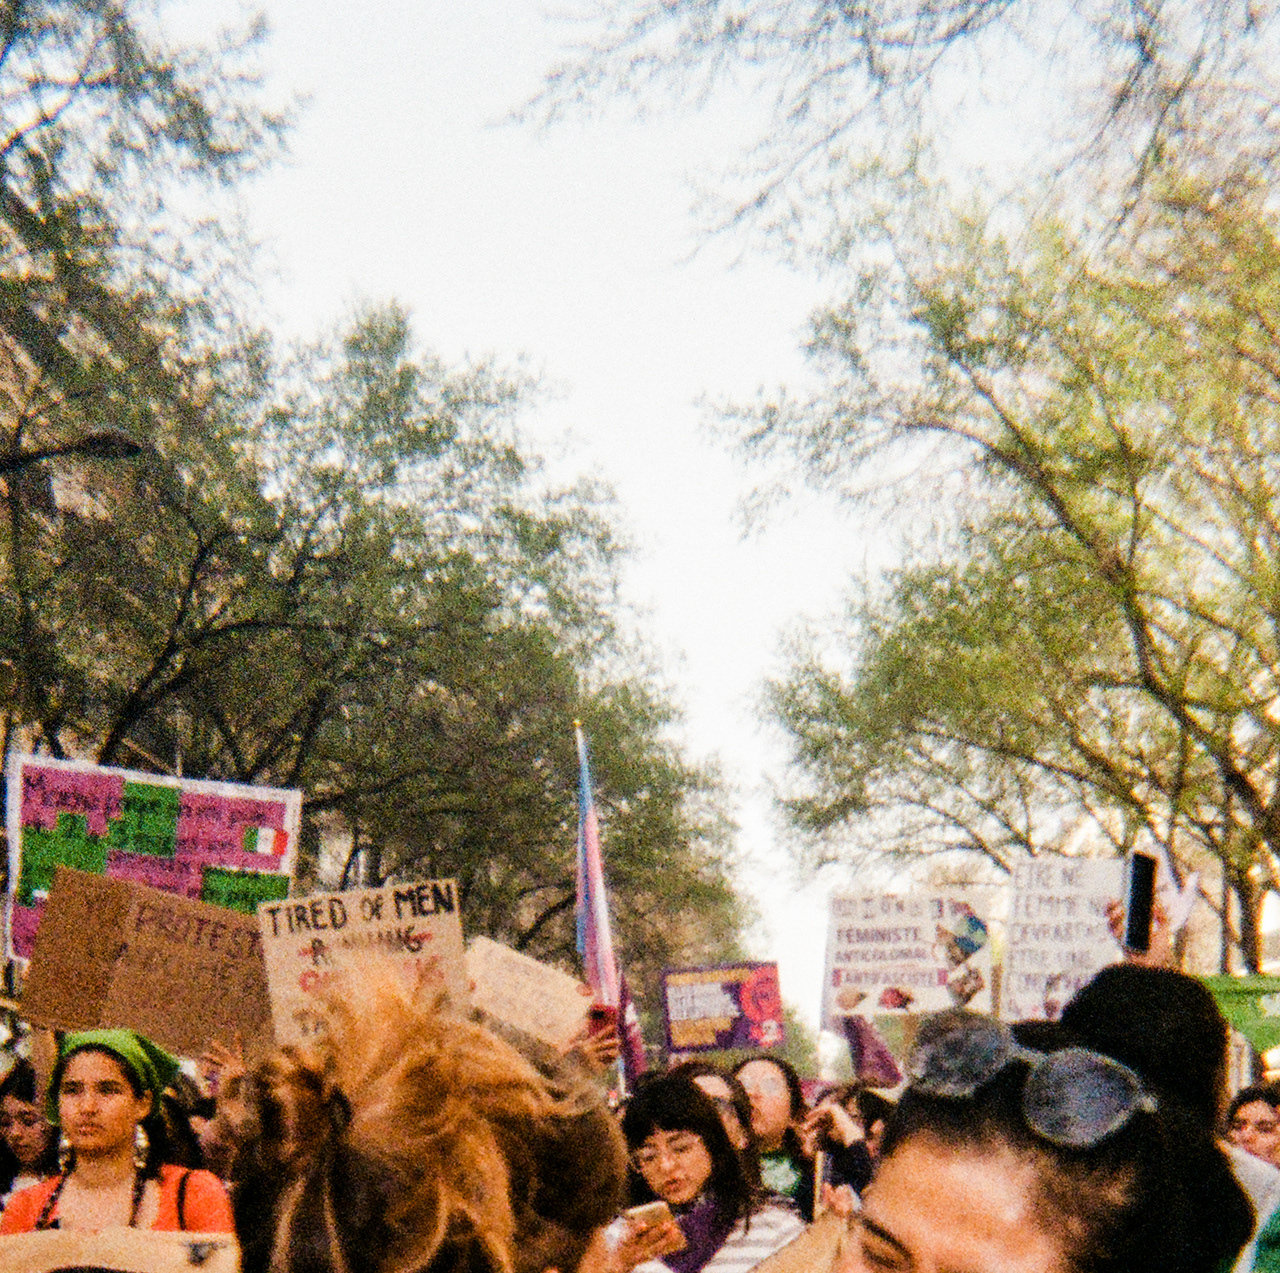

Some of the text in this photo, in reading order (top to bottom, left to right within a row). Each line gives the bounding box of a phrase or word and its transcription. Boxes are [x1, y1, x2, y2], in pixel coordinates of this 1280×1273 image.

[267, 884, 455, 938] TIRED OF MEN
[835, 922, 920, 946] FÉMINISTE
[844, 968, 934, 986] ANTIFASCISTE
